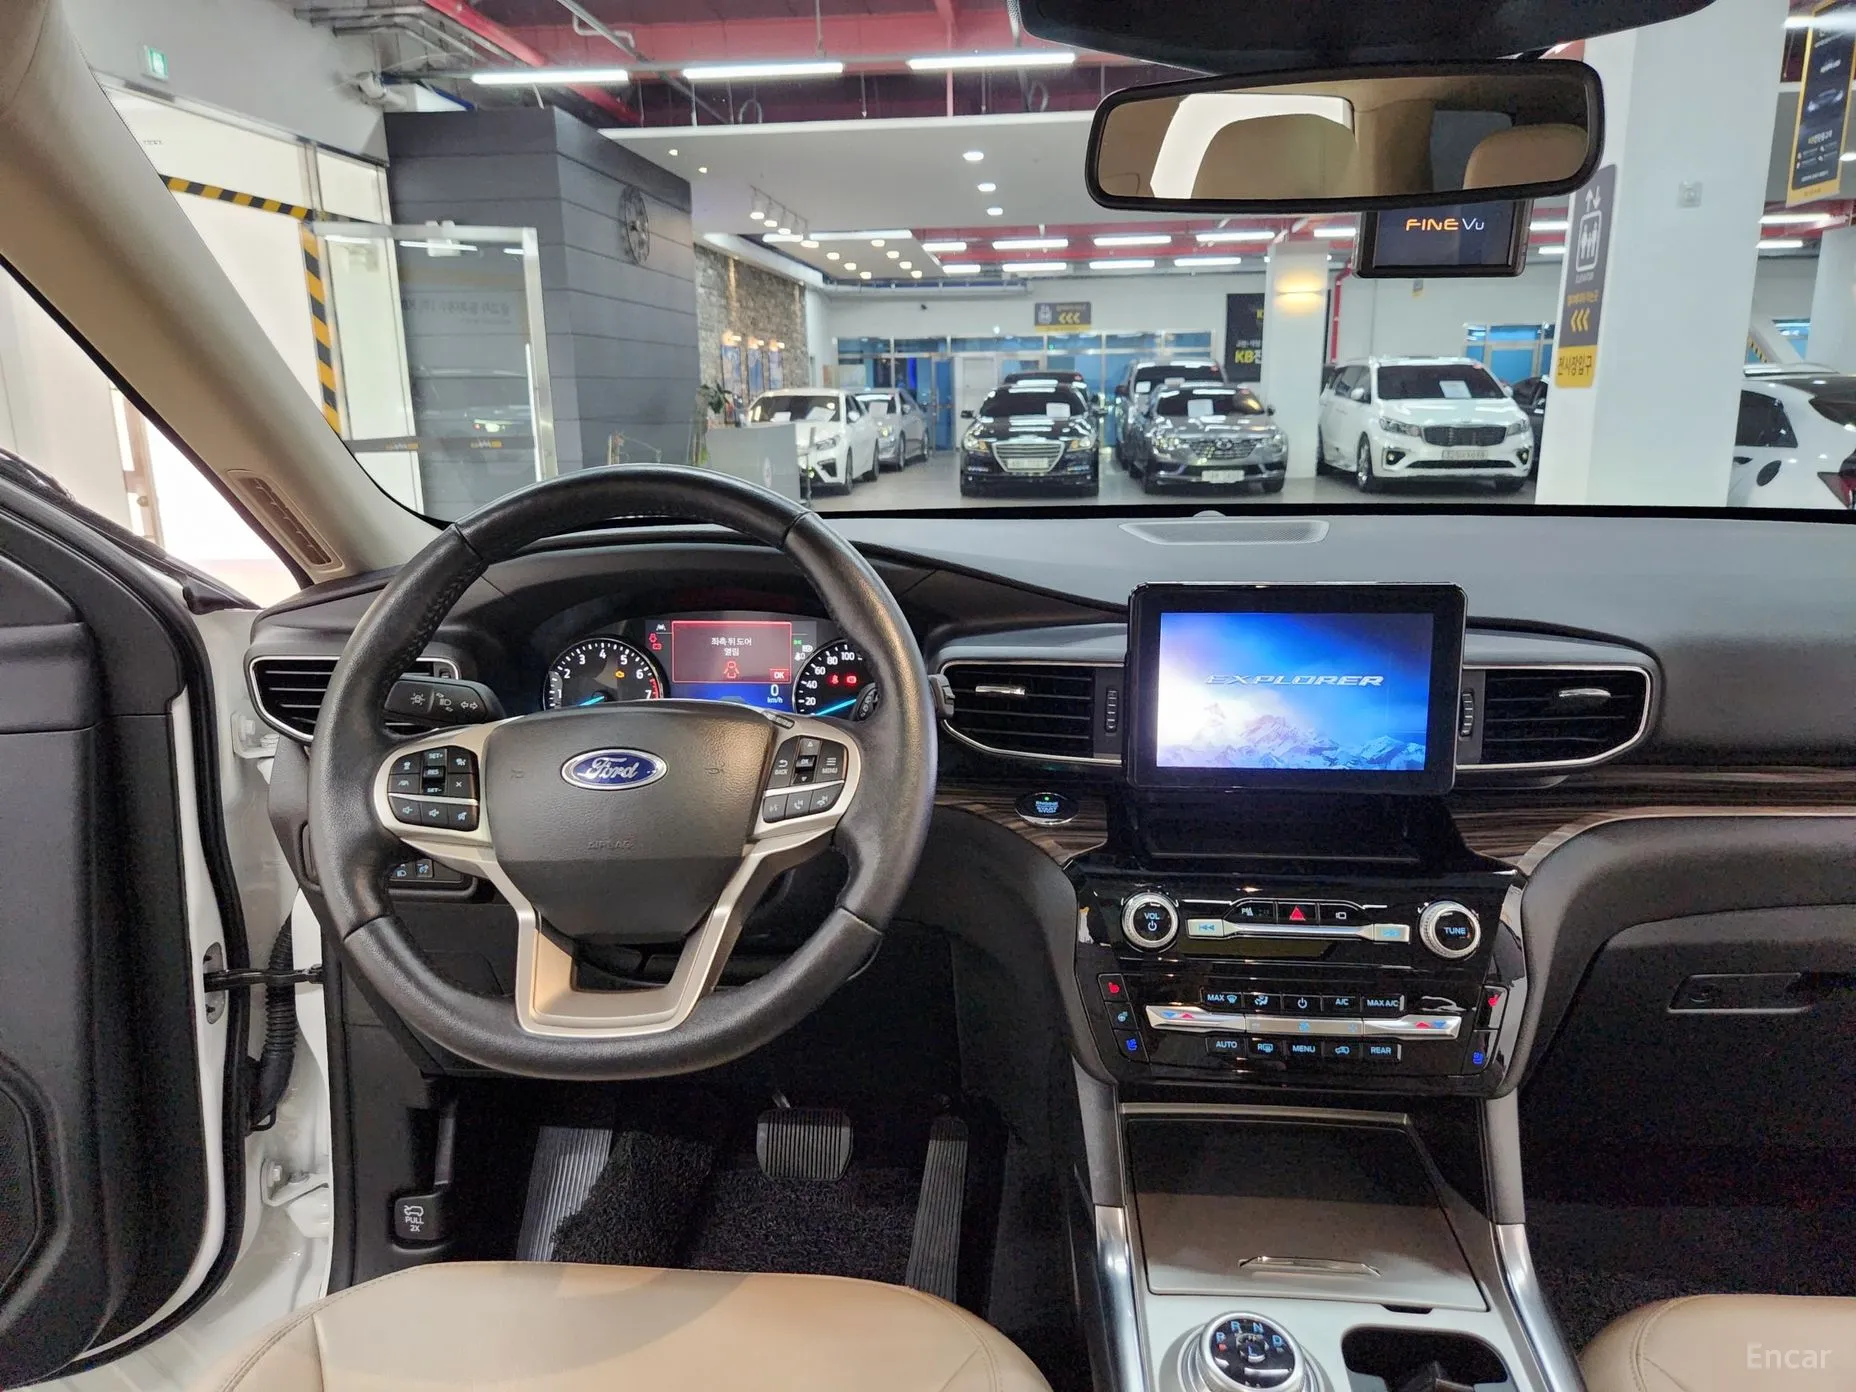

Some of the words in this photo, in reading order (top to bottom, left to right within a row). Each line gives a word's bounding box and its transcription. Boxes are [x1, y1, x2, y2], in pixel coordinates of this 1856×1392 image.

[1405, 218, 1459, 231] FINE
[1461, 218, 1485, 231] Vu
[727, 637, 736, 647] 뒤
[736, 637, 752, 647] 도어
[599, 649, 606, 659] 4
[724, 648, 740, 657] 열림
[841, 652, 855, 660] 100
[579, 655, 586, 664] 3
[620, 655, 628, 665] 5
[826, 656, 838, 665] 80
[564, 669, 571, 679] 2
[636, 669, 643, 679] 6
[814, 667, 826, 675] 60
[806, 680, 818, 689] 40
[1203, 675, 1385, 687] EXPLORER
[557, 689, 562, 699] 1
[645, 690, 652, 699] 7
[770, 684, 779, 696] 0
[767, 696, 783, 704] km/h
[805, 697, 816, 706] 20
[577, 757, 640, 780] Ford
[1144, 912, 1160, 920] VOL
[1443, 927, 1466, 935] TUNE
[1335, 998, 1349, 1006] A/C
[1292, 1045, 1316, 1053] MENU
[1370, 1046, 1392, 1054] REAR
[405, 1216, 424, 1225] PULL
[1231, 1320, 1242, 1333] R
[1252, 1322, 1264, 1334] N
[1272, 1334, 1285, 1347] D
[1247, 1345, 1259, 1357] L
